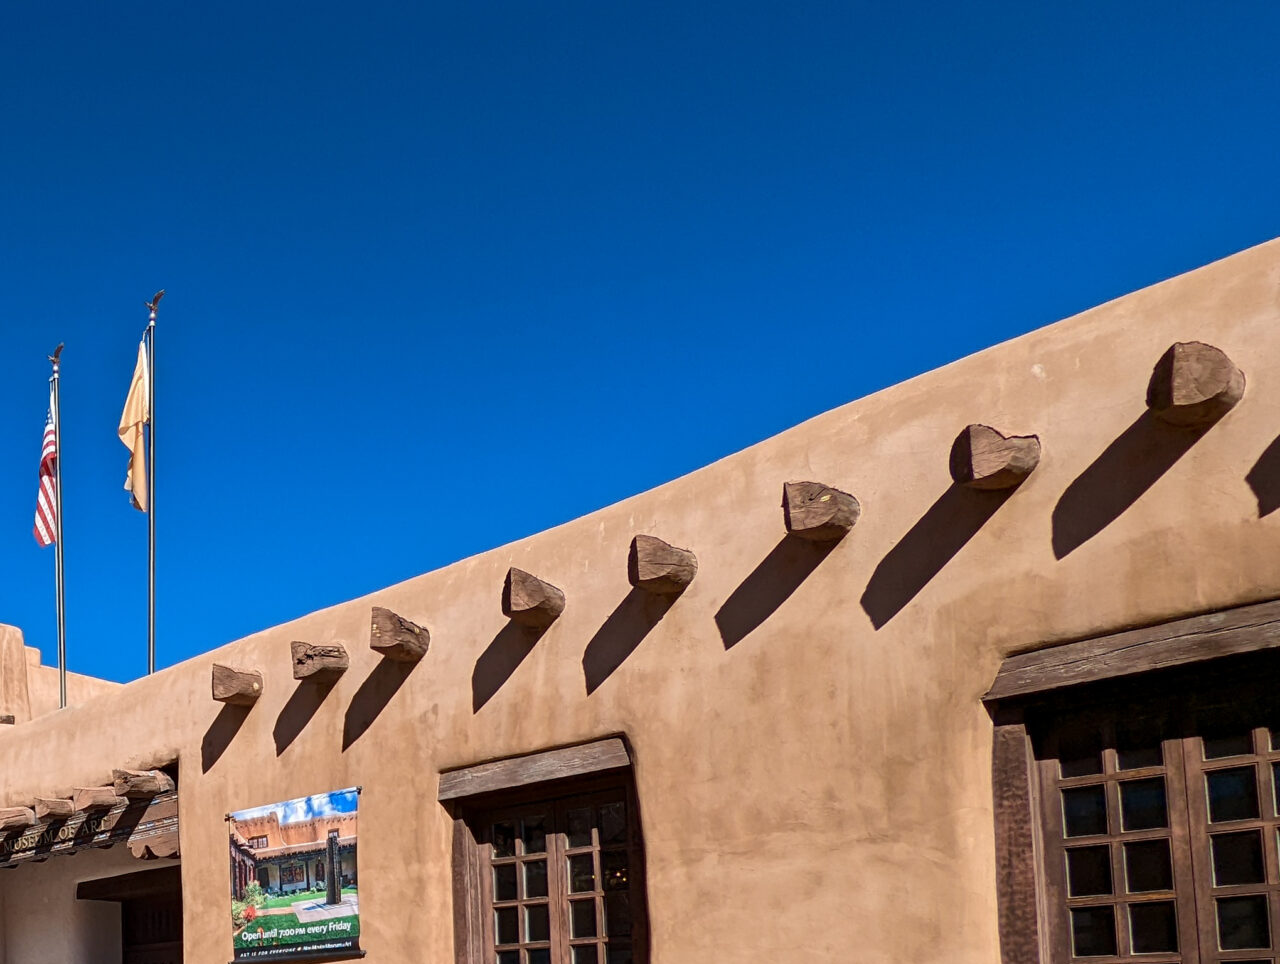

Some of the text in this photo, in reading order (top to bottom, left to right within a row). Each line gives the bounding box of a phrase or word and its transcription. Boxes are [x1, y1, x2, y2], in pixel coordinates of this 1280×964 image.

[242, 931, 261, 941] Open
[263, 928, 278, 938] until
[278, 929, 295, 938] 7:00
[307, 925, 327, 935] every
[328, 921, 351, 931] Friday
